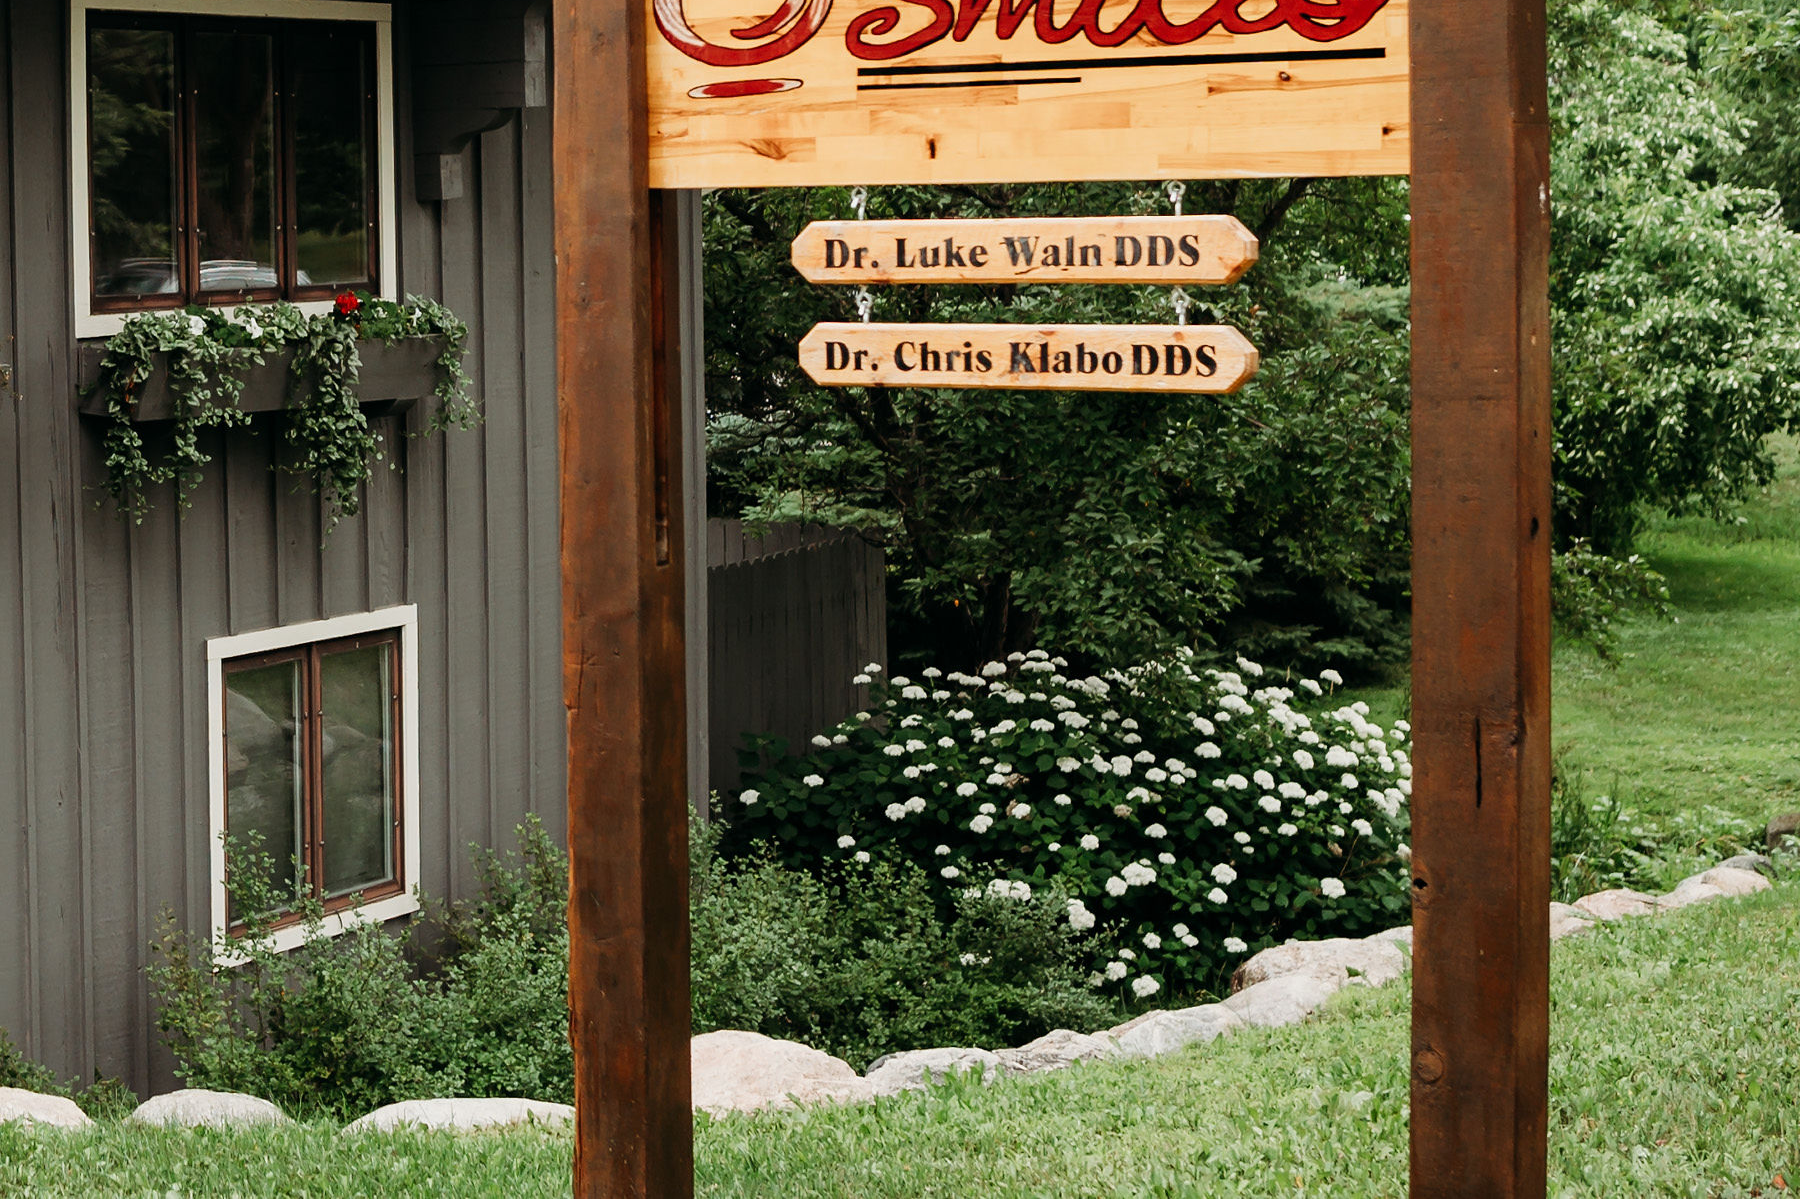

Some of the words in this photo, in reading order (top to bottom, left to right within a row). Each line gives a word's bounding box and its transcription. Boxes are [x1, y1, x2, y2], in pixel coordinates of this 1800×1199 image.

[824, 238, 880, 269] Dr.
[894, 237, 989, 268] Luke
[1002, 236, 1103, 268] Waln
[1113, 233, 1201, 267] DDS
[824, 341, 879, 372] Dr.
[893, 341, 993, 373] Chris
[1008, 341, 1124, 375] Klabo
[1131, 344, 1218, 378] DDS
